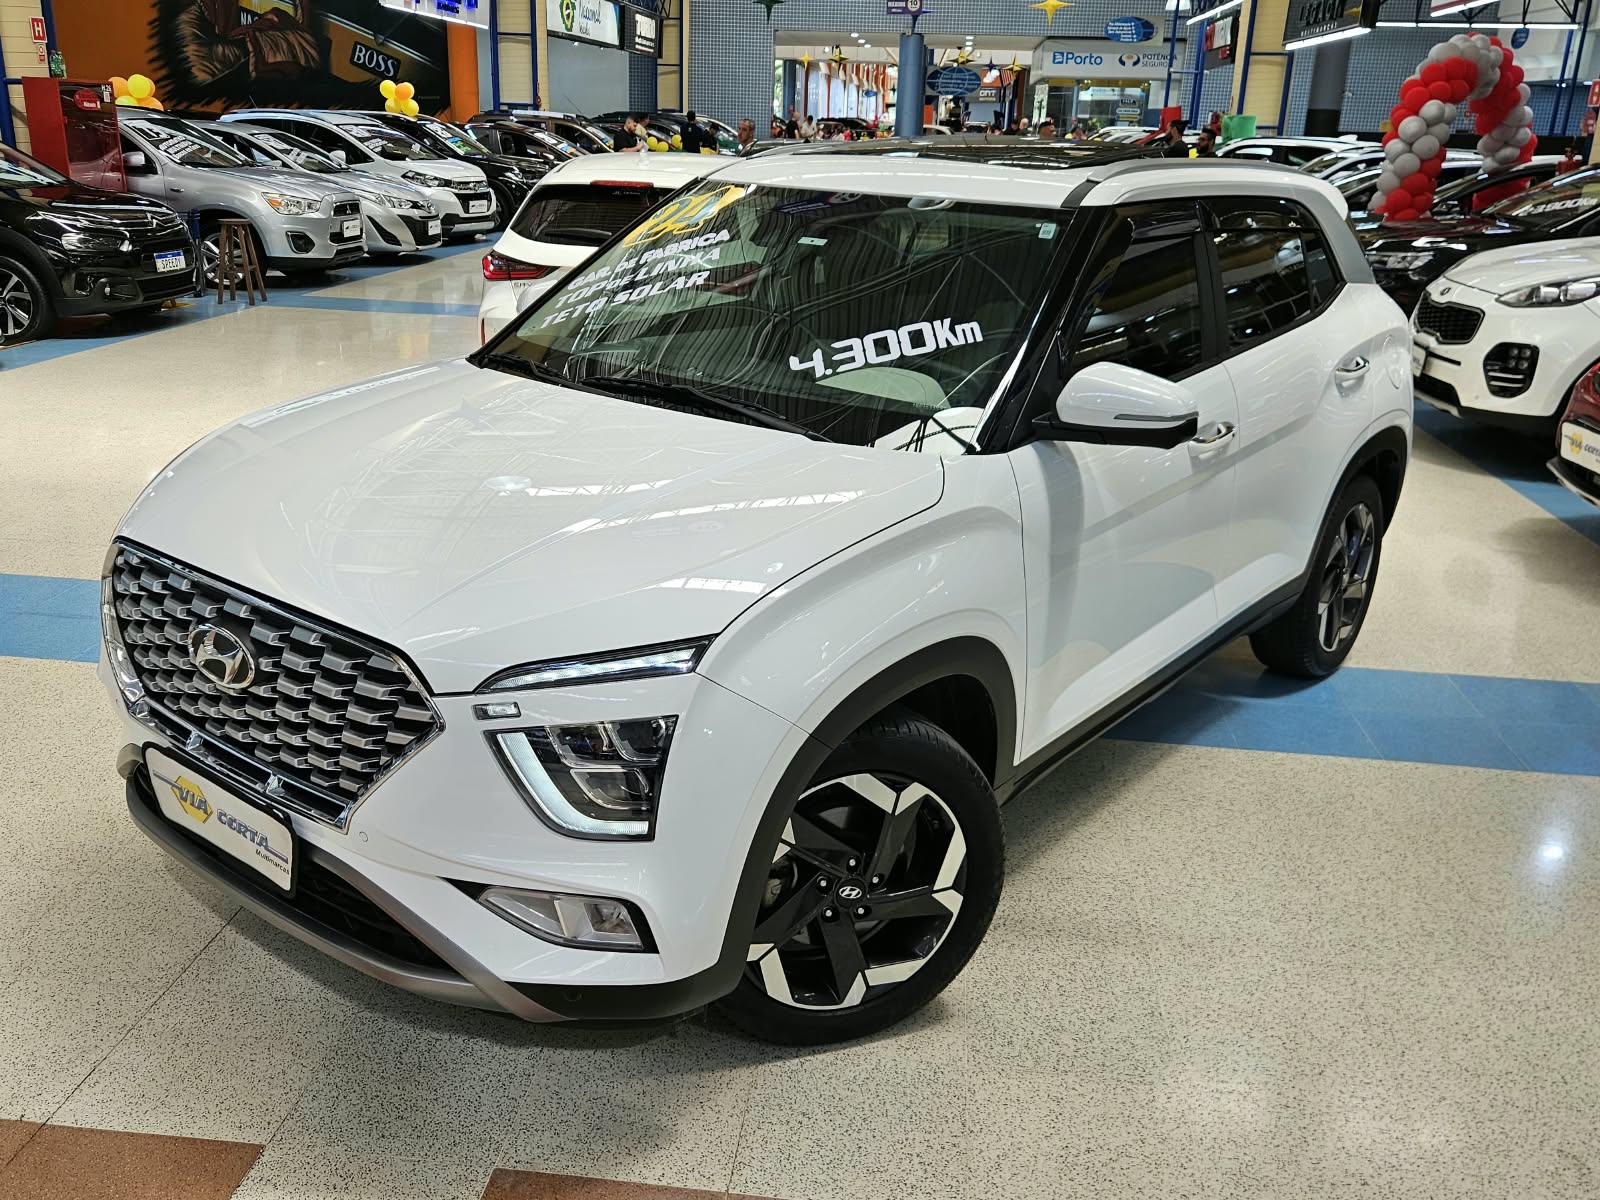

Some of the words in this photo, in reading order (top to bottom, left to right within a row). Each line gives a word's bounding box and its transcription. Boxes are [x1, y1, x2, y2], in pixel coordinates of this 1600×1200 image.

[34, 22, 43, 37] H
[354, 44, 397, 77] BOSS
[1065, 52, 1103, 65] Porto
[1142, 53, 1178, 61] POTÊNCA
[639, 229, 730, 264] FABRICA
[555, 280, 608, 309] TOP
[634, 248, 720, 282] LINHA
[541, 296, 608, 328] TETO
[613, 271, 710, 306] SOLAR
[788, 317, 984, 379] 4.300Km
[176, 786, 210, 816] VIA
[216, 808, 271, 851] CERTA
[255, 848, 290, 876] Multimarcas
